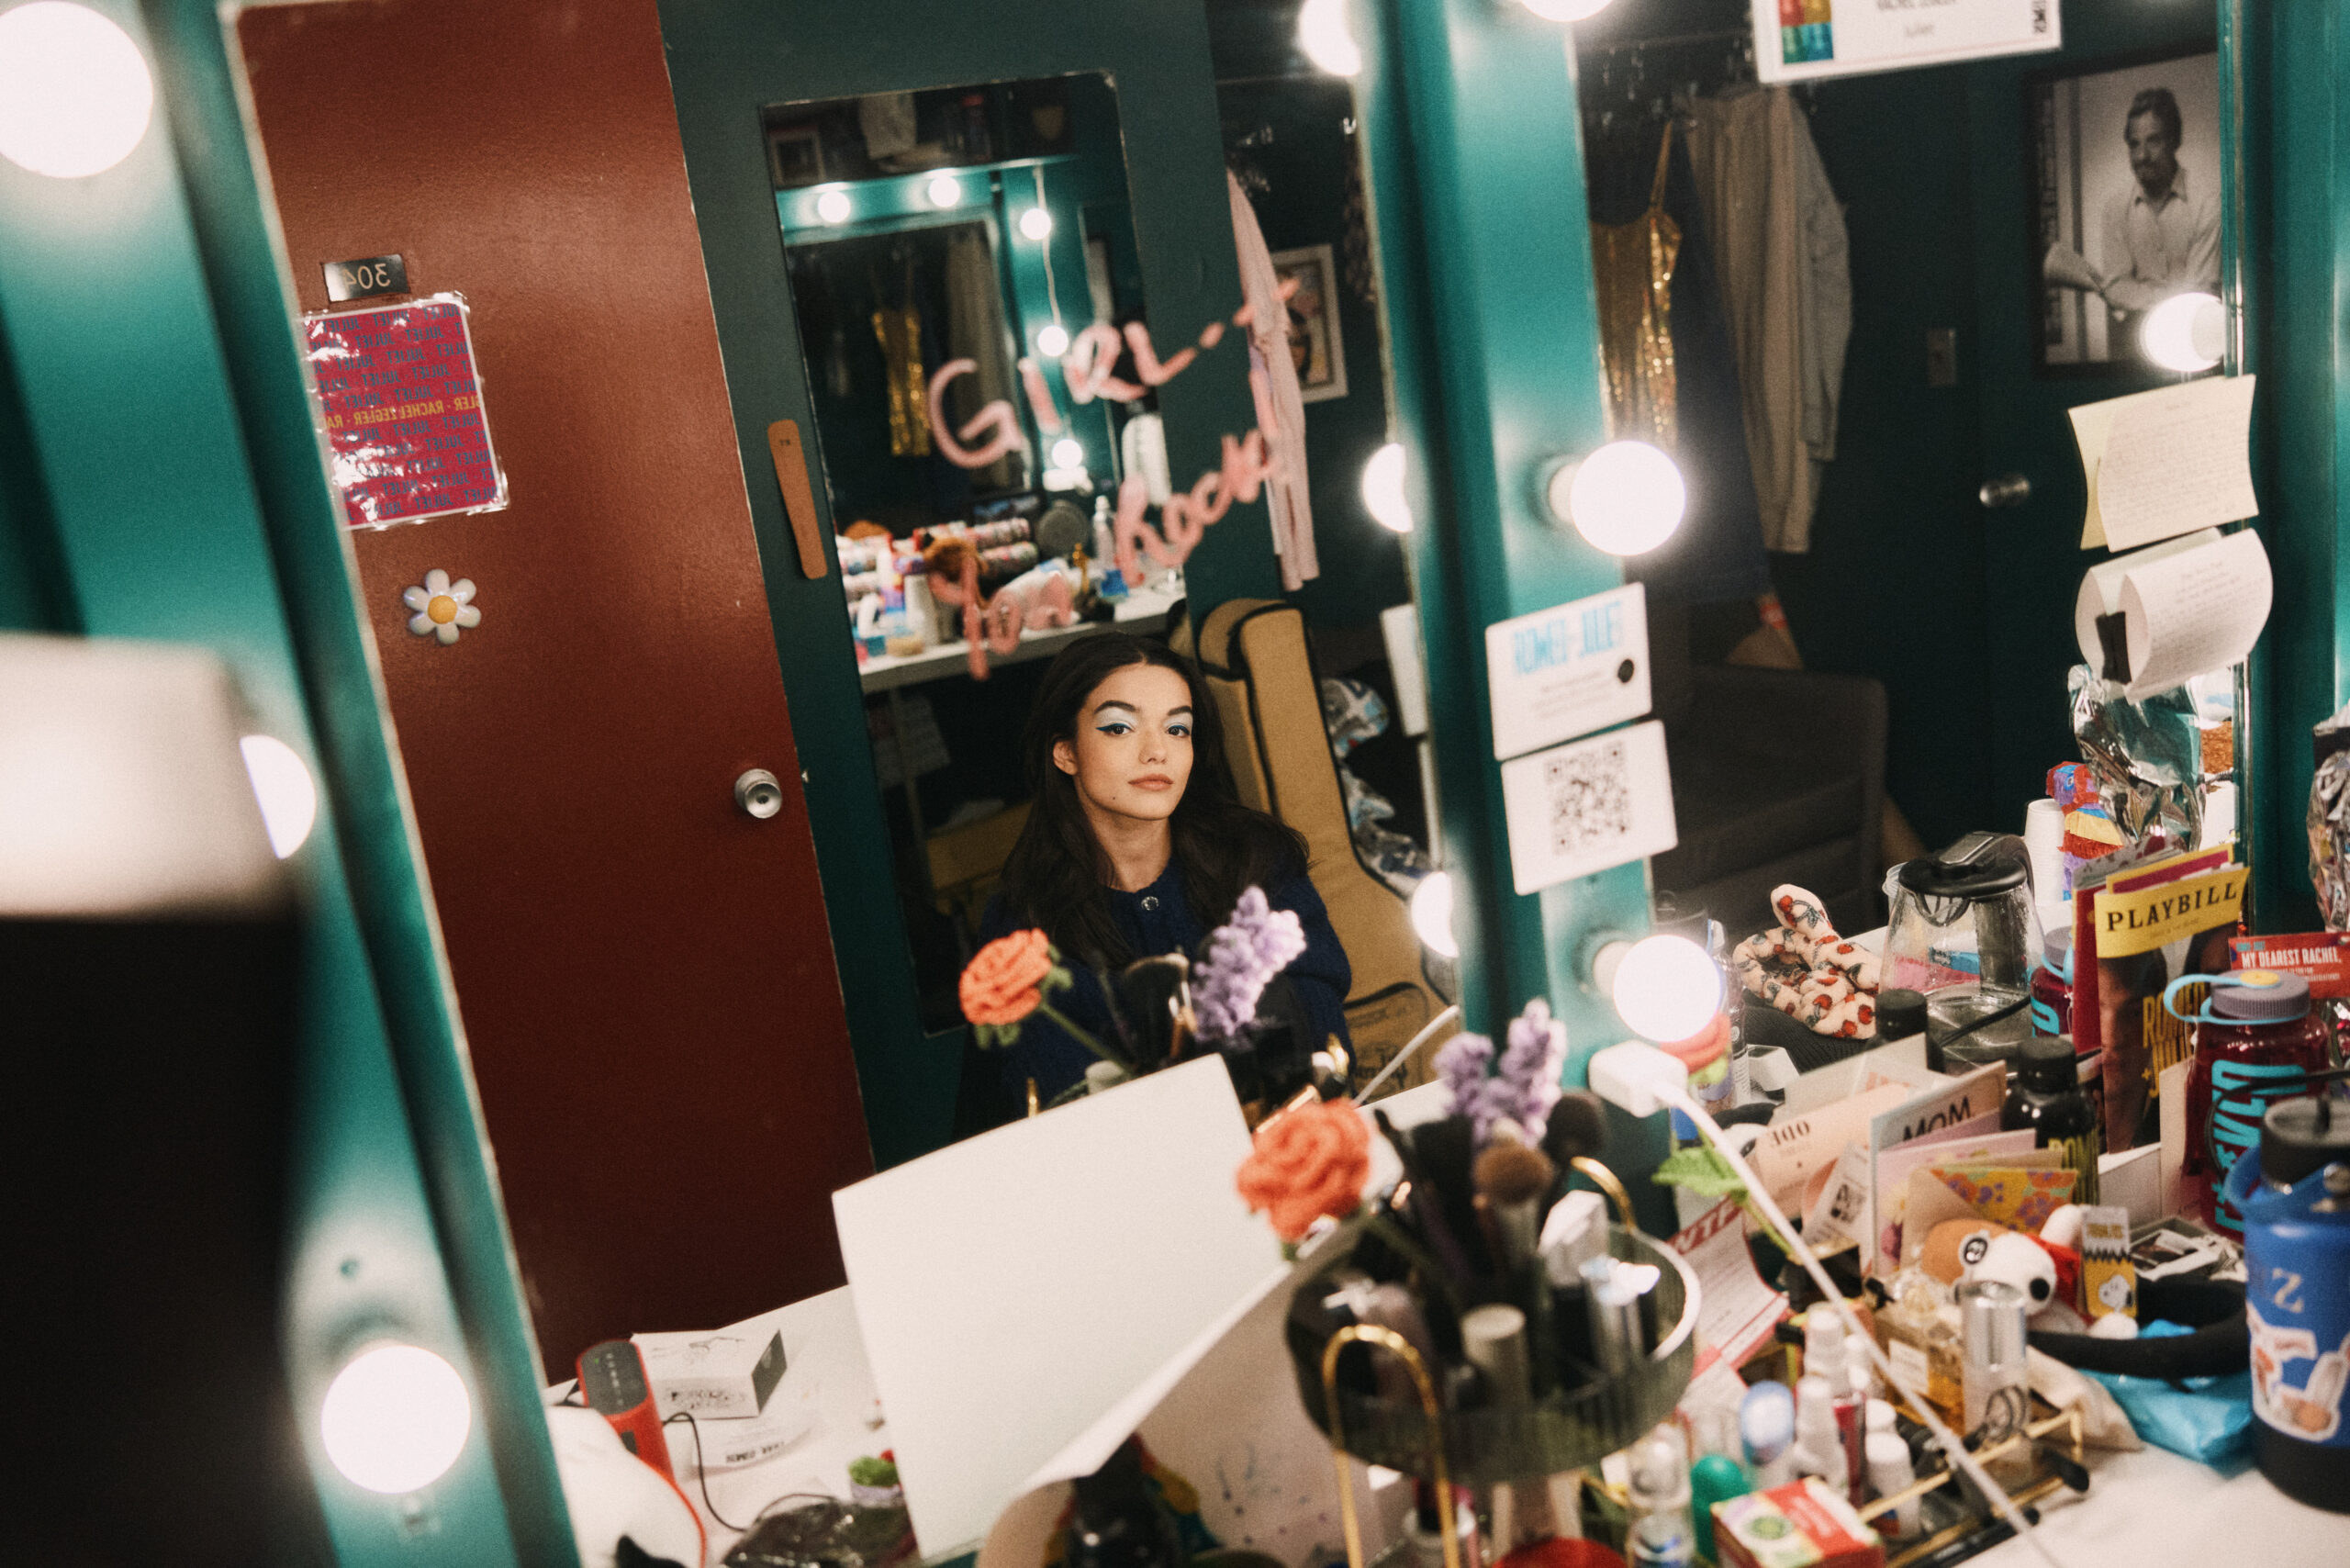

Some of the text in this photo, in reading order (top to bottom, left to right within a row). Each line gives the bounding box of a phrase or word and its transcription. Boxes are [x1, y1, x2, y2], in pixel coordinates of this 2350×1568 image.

[2107, 881, 2238, 932] PLAYBILL
[2241, 952, 2256, 969] MY
[2258, 948, 2300, 968] DEAREST
